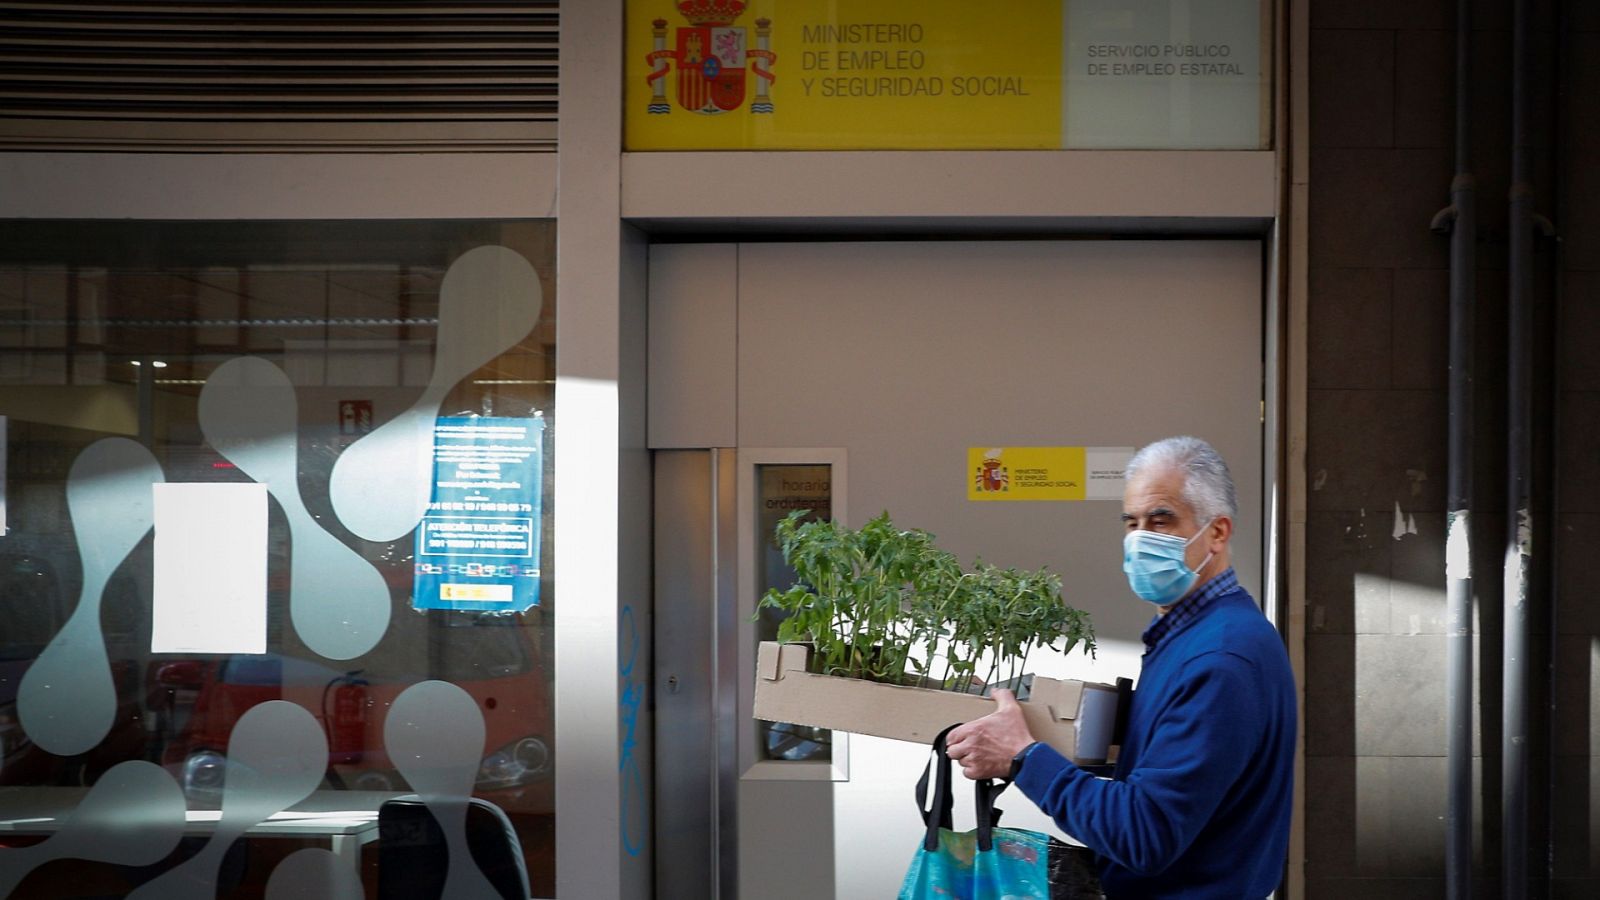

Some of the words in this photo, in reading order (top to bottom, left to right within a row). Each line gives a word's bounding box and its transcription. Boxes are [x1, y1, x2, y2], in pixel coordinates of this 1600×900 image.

[802, 23, 924, 44] MINISTERIO
[1087, 45, 1160, 57] SERVICIO
[1164, 44, 1231, 57] PÚBLICO
[802, 51, 830, 71] DE
[837, 50, 925, 71] EMPLEO
[1087, 63, 1109, 76] DE
[1112, 63, 1176, 76] EMPLEO
[1180, 62, 1244, 76] ESTATAL
[801, 78, 816, 97] Y
[822, 76, 943, 97] SEGURIDAD
[951, 76, 1030, 97] SOCIAL
[782, 479, 830, 491] horario
